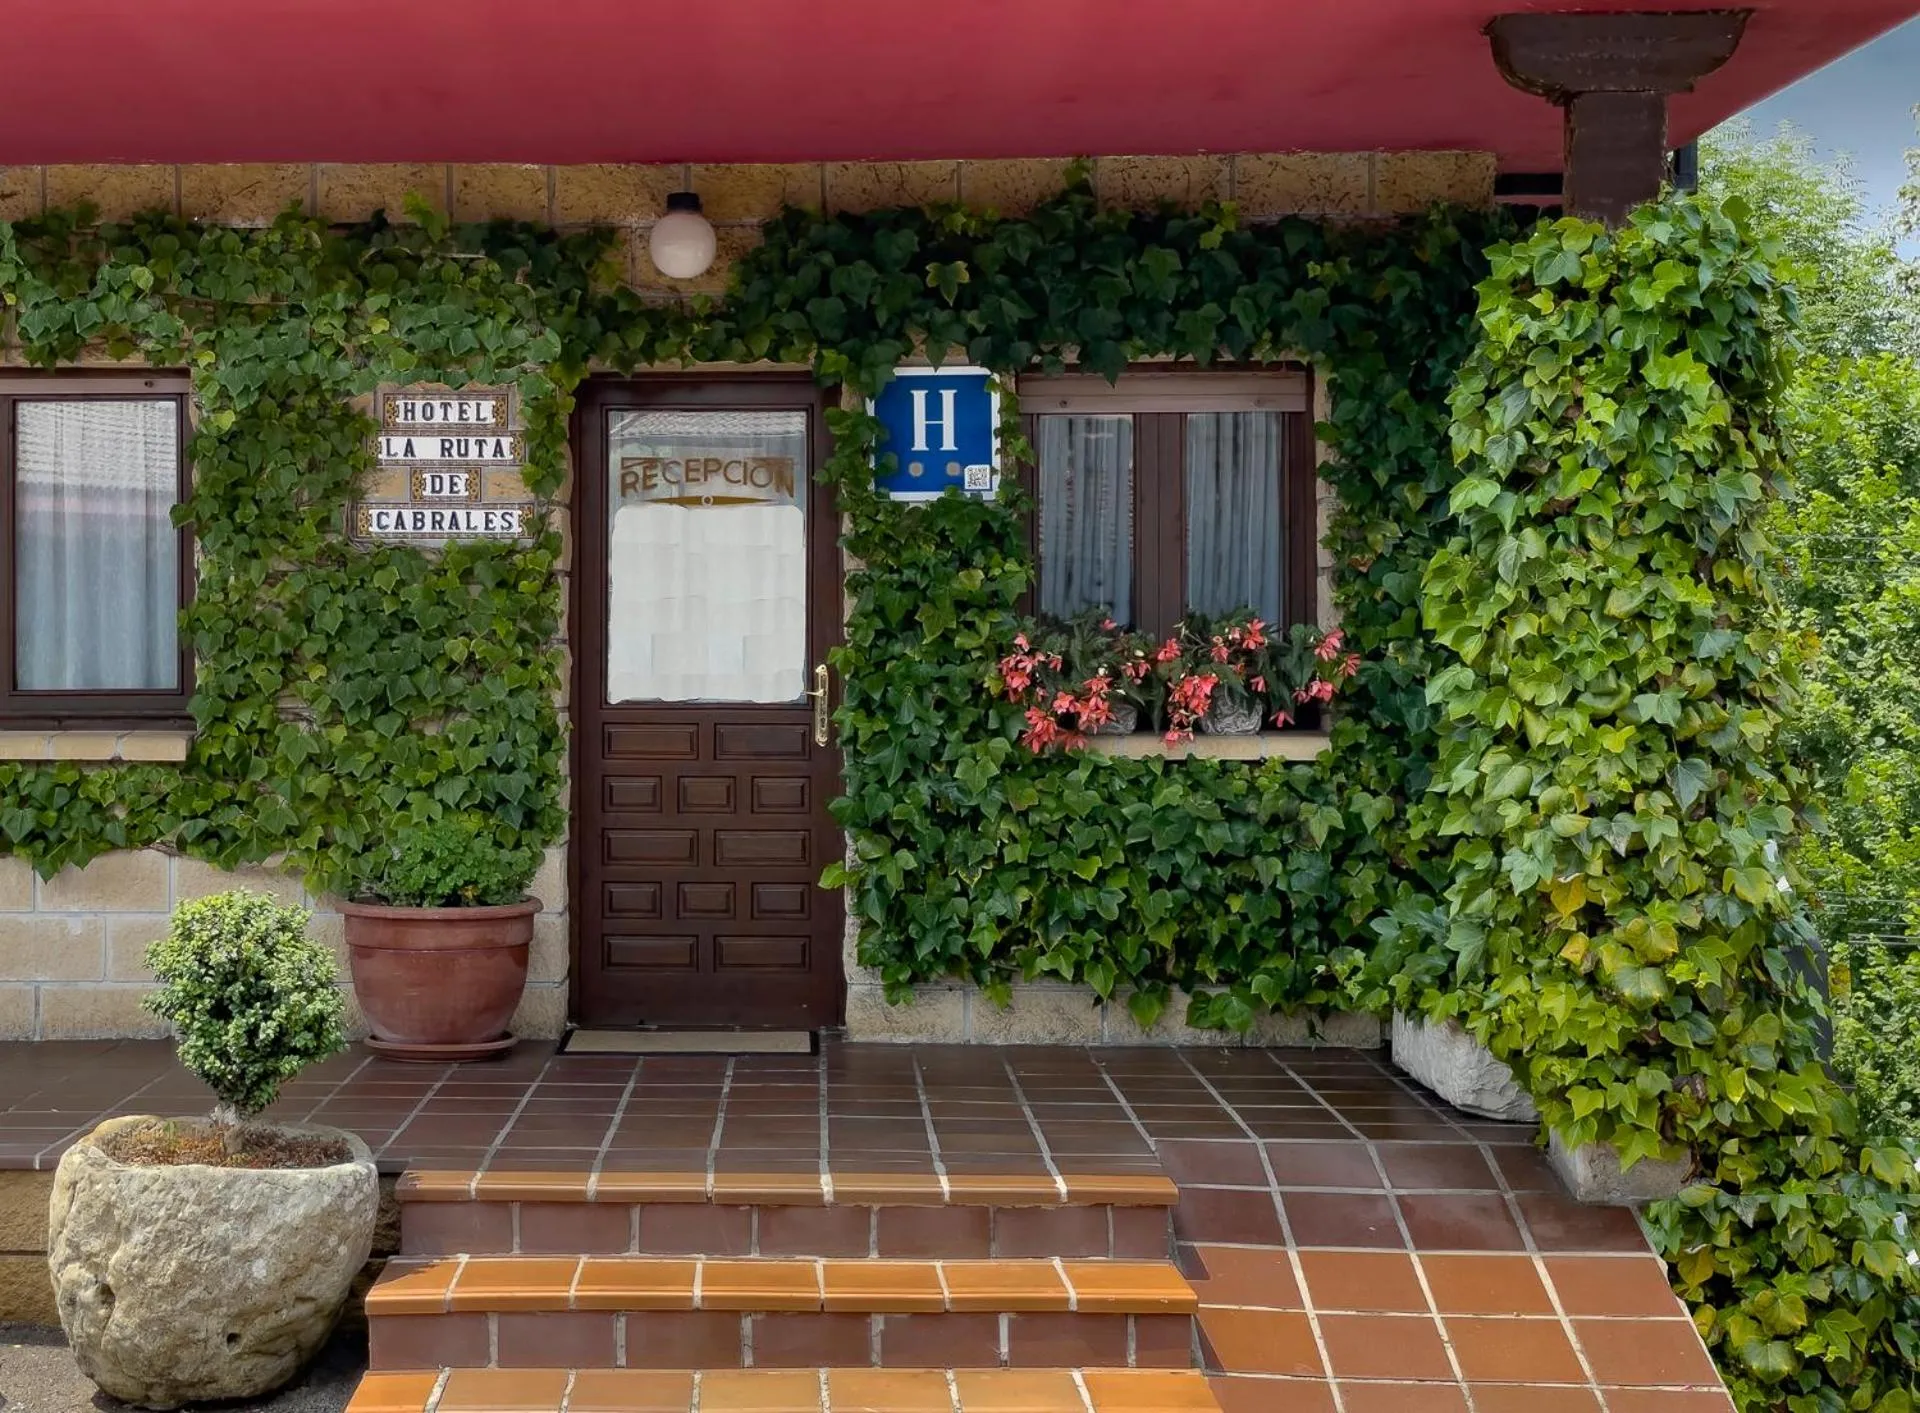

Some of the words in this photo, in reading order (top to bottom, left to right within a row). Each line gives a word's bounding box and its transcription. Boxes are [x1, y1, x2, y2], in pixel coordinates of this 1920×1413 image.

[403, 402, 488, 422] HOTEL
[910, 389, 958, 451] H
[386, 438, 417, 458] LA
[440, 438, 506, 458] RUTA
[430, 474, 463, 494] DE
[376, 511, 514, 532] CABRALES
